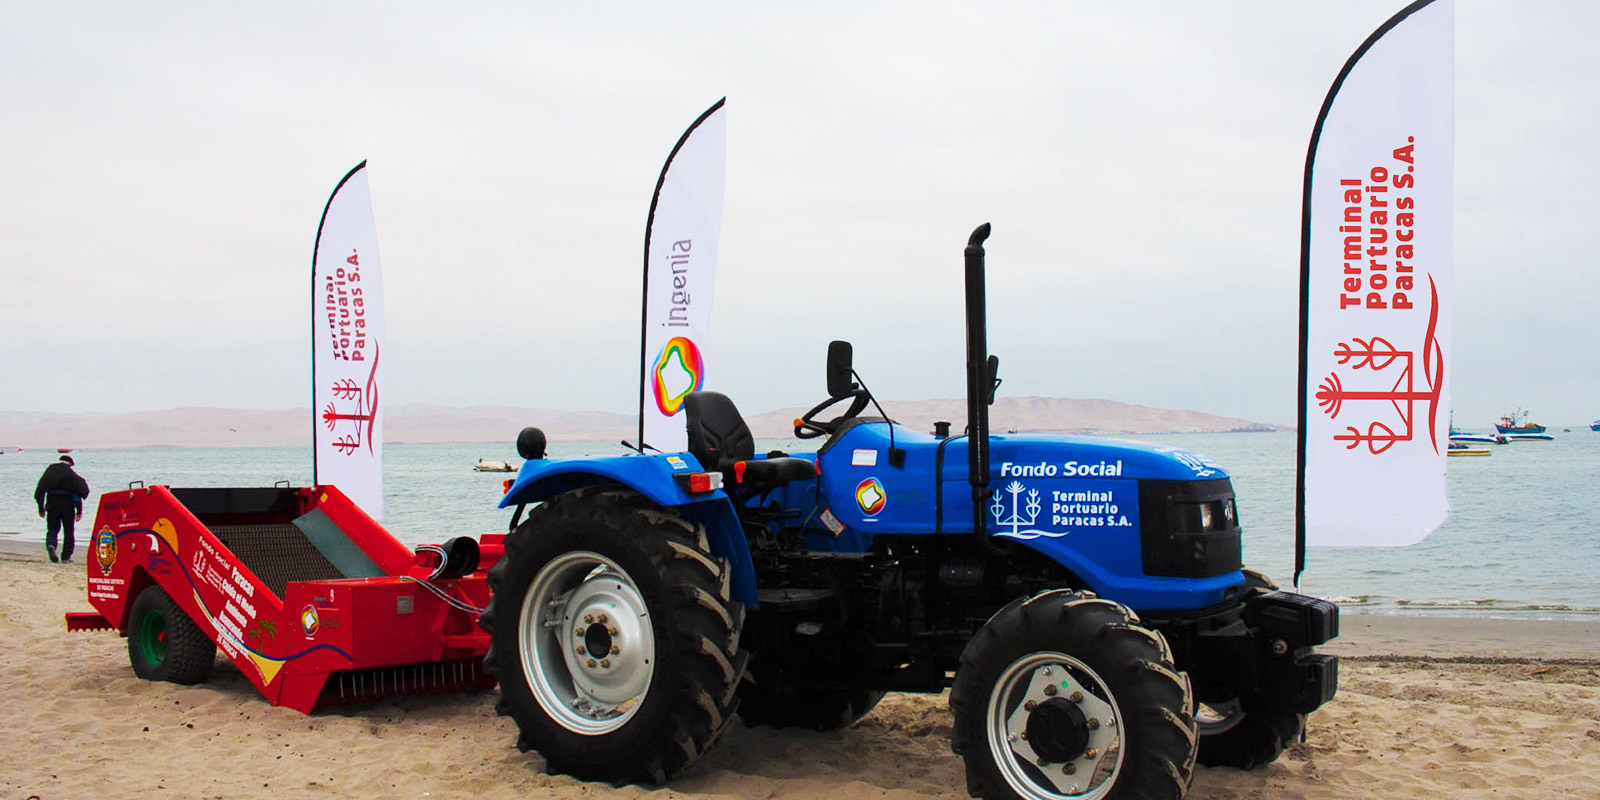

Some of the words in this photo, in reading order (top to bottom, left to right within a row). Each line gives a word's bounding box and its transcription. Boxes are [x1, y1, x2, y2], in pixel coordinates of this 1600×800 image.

[1392, 135, 1415, 189] S.A.
[346, 248, 361, 282] S.A.
[1339, 178, 1362, 310] Terminal
[1365, 166, 1388, 310] Portuario
[1392, 196, 1414, 310] Paracas
[662, 239, 692, 327] ingenia
[326, 275, 341, 360] Terminal
[334, 267, 351, 361] Portuario
[351, 287, 366, 362] Paracas
[1001, 462, 1058, 477] Fondo
[1063, 460, 1122, 476] Social
[1052, 490, 1113, 502] Terminal
[1052, 503, 1119, 514] Portuario
[1052, 515, 1104, 526] Paracas
[1107, 515, 1133, 527] S.A.
[199, 535, 214, 555] Fondo
[214, 551, 231, 571] Social
[231, 566, 255, 598] Paracas
